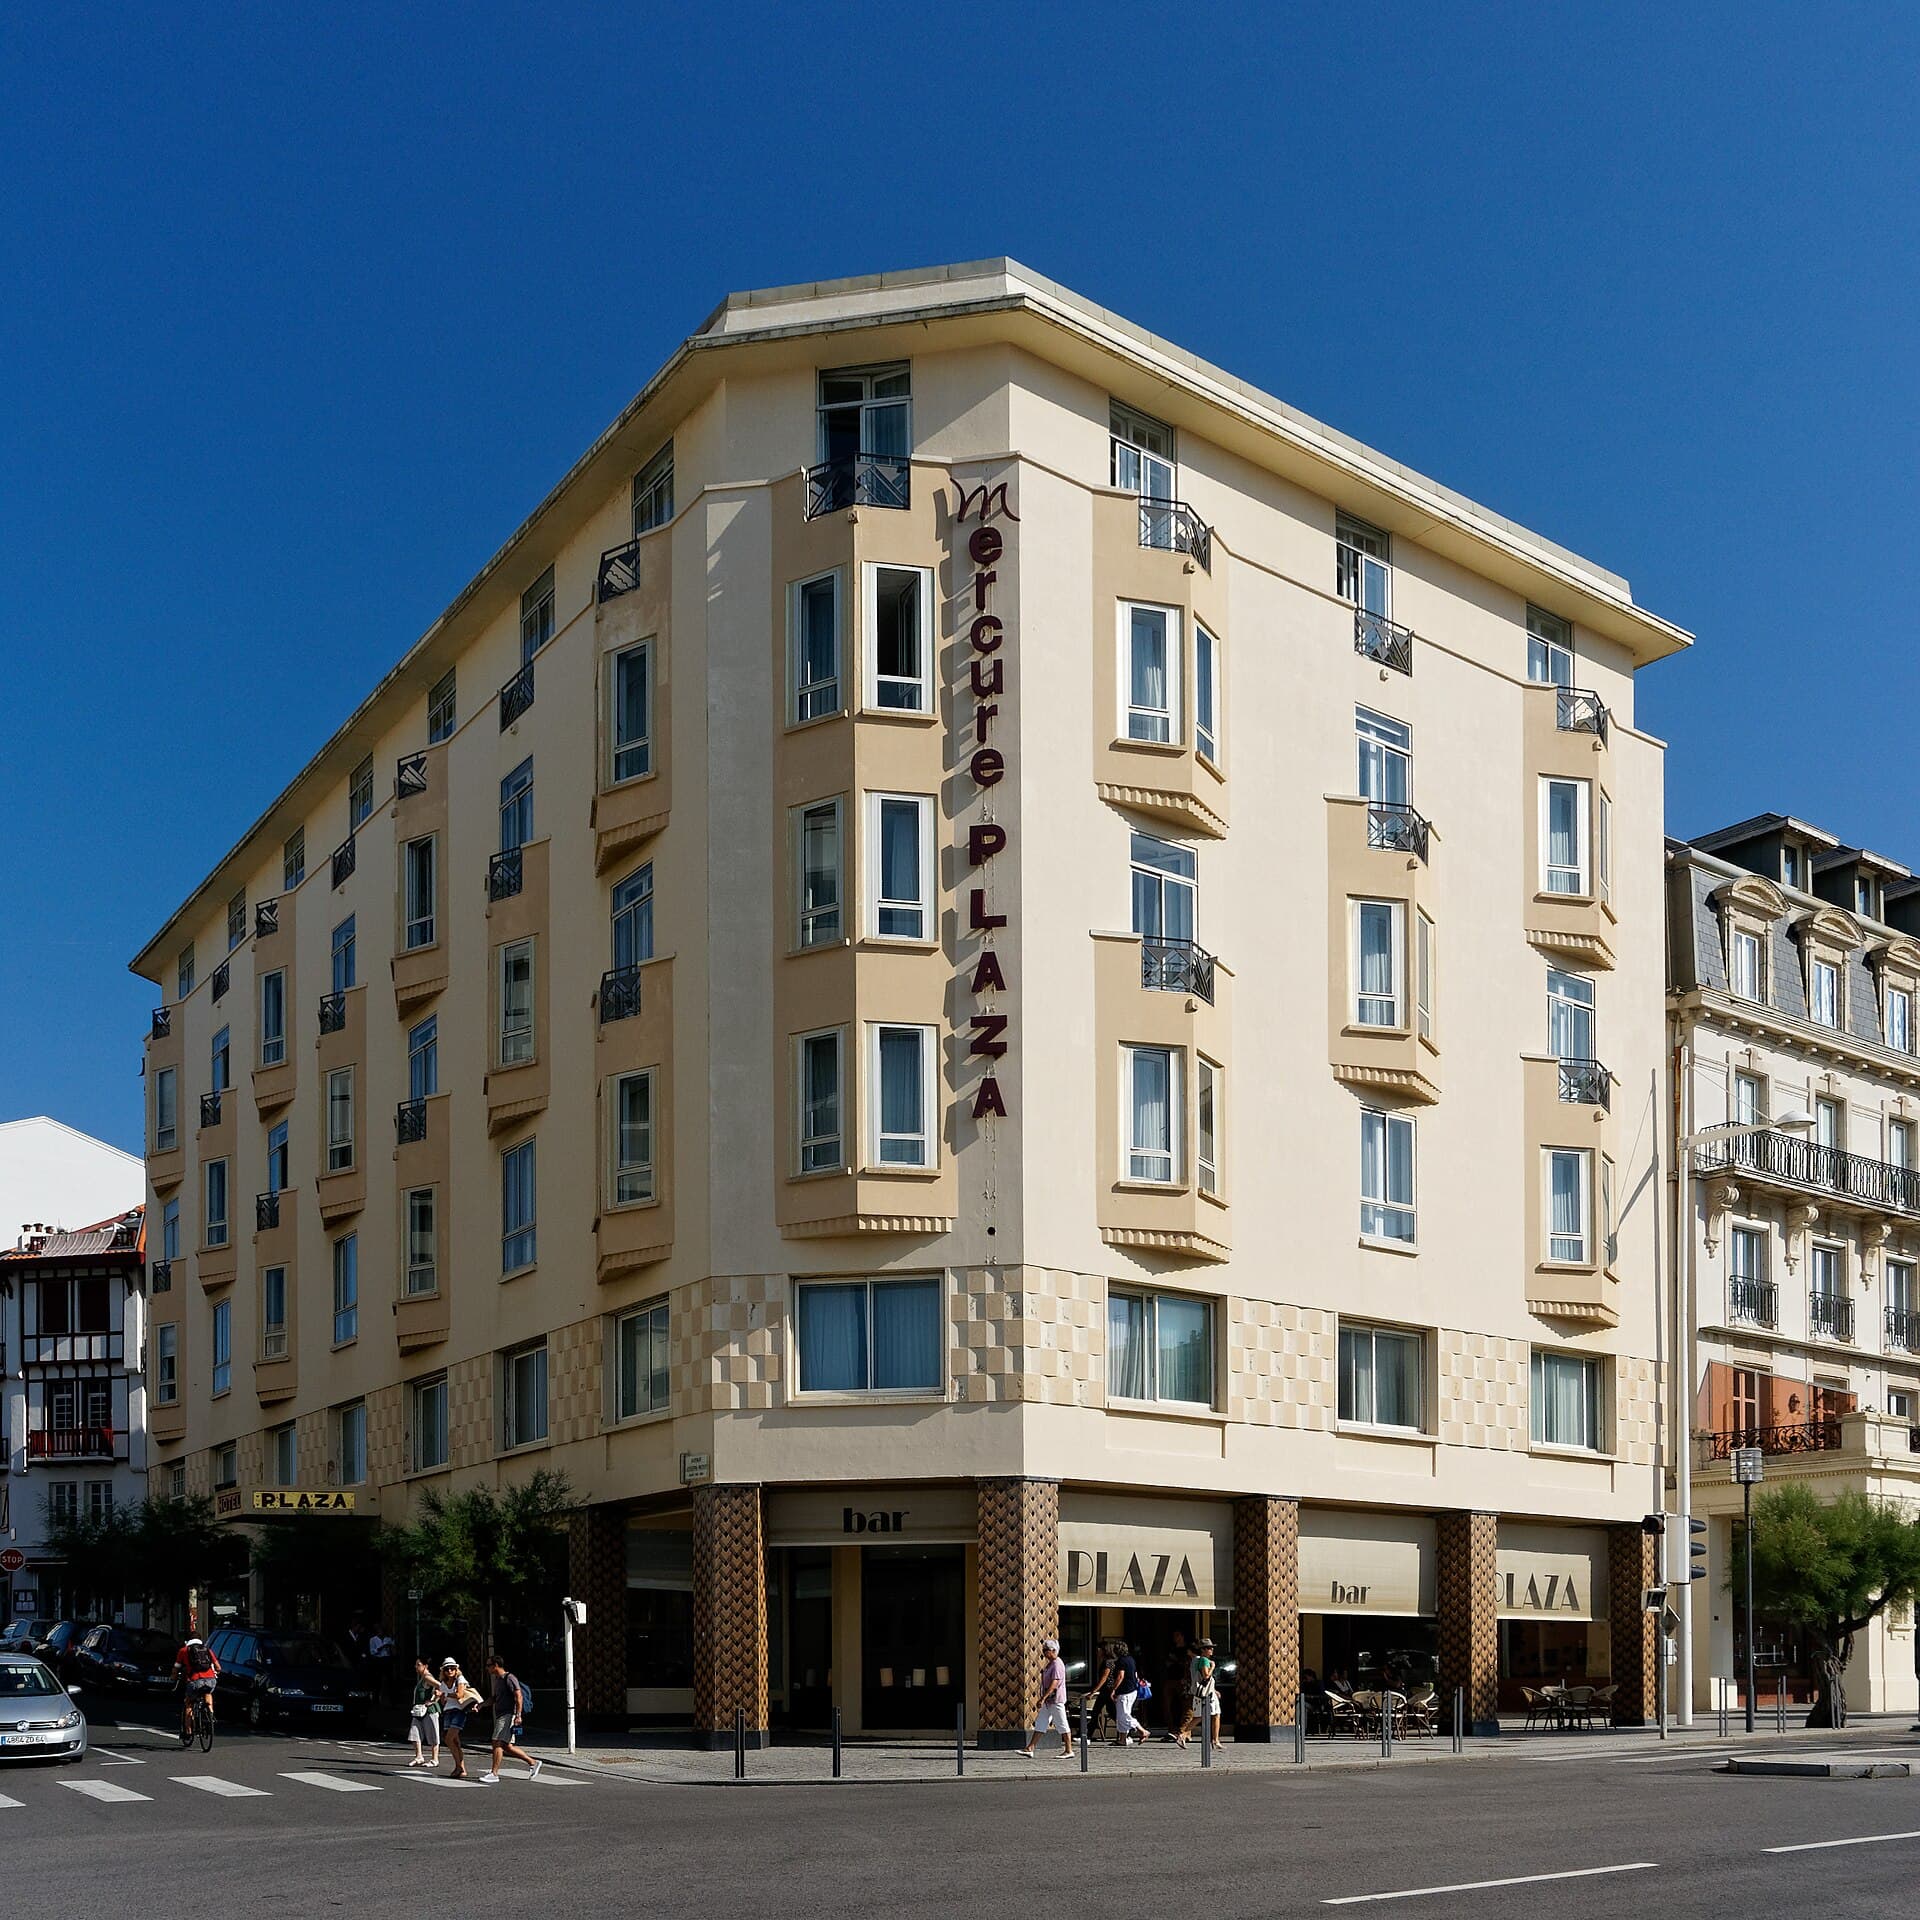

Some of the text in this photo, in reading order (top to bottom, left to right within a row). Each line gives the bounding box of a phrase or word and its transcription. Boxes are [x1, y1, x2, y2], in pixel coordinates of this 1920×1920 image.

[968, 823, 1008, 1119] PLAZA
[218, 1494, 241, 1513] HOTEL
[261, 1492, 347, 1508] PLAZA
[843, 1507, 910, 1533] bar
[1, 1555, 23, 1564] STOP
[1067, 1550, 1199, 1598] PLAZA
[1331, 1580, 1371, 1604] bar
